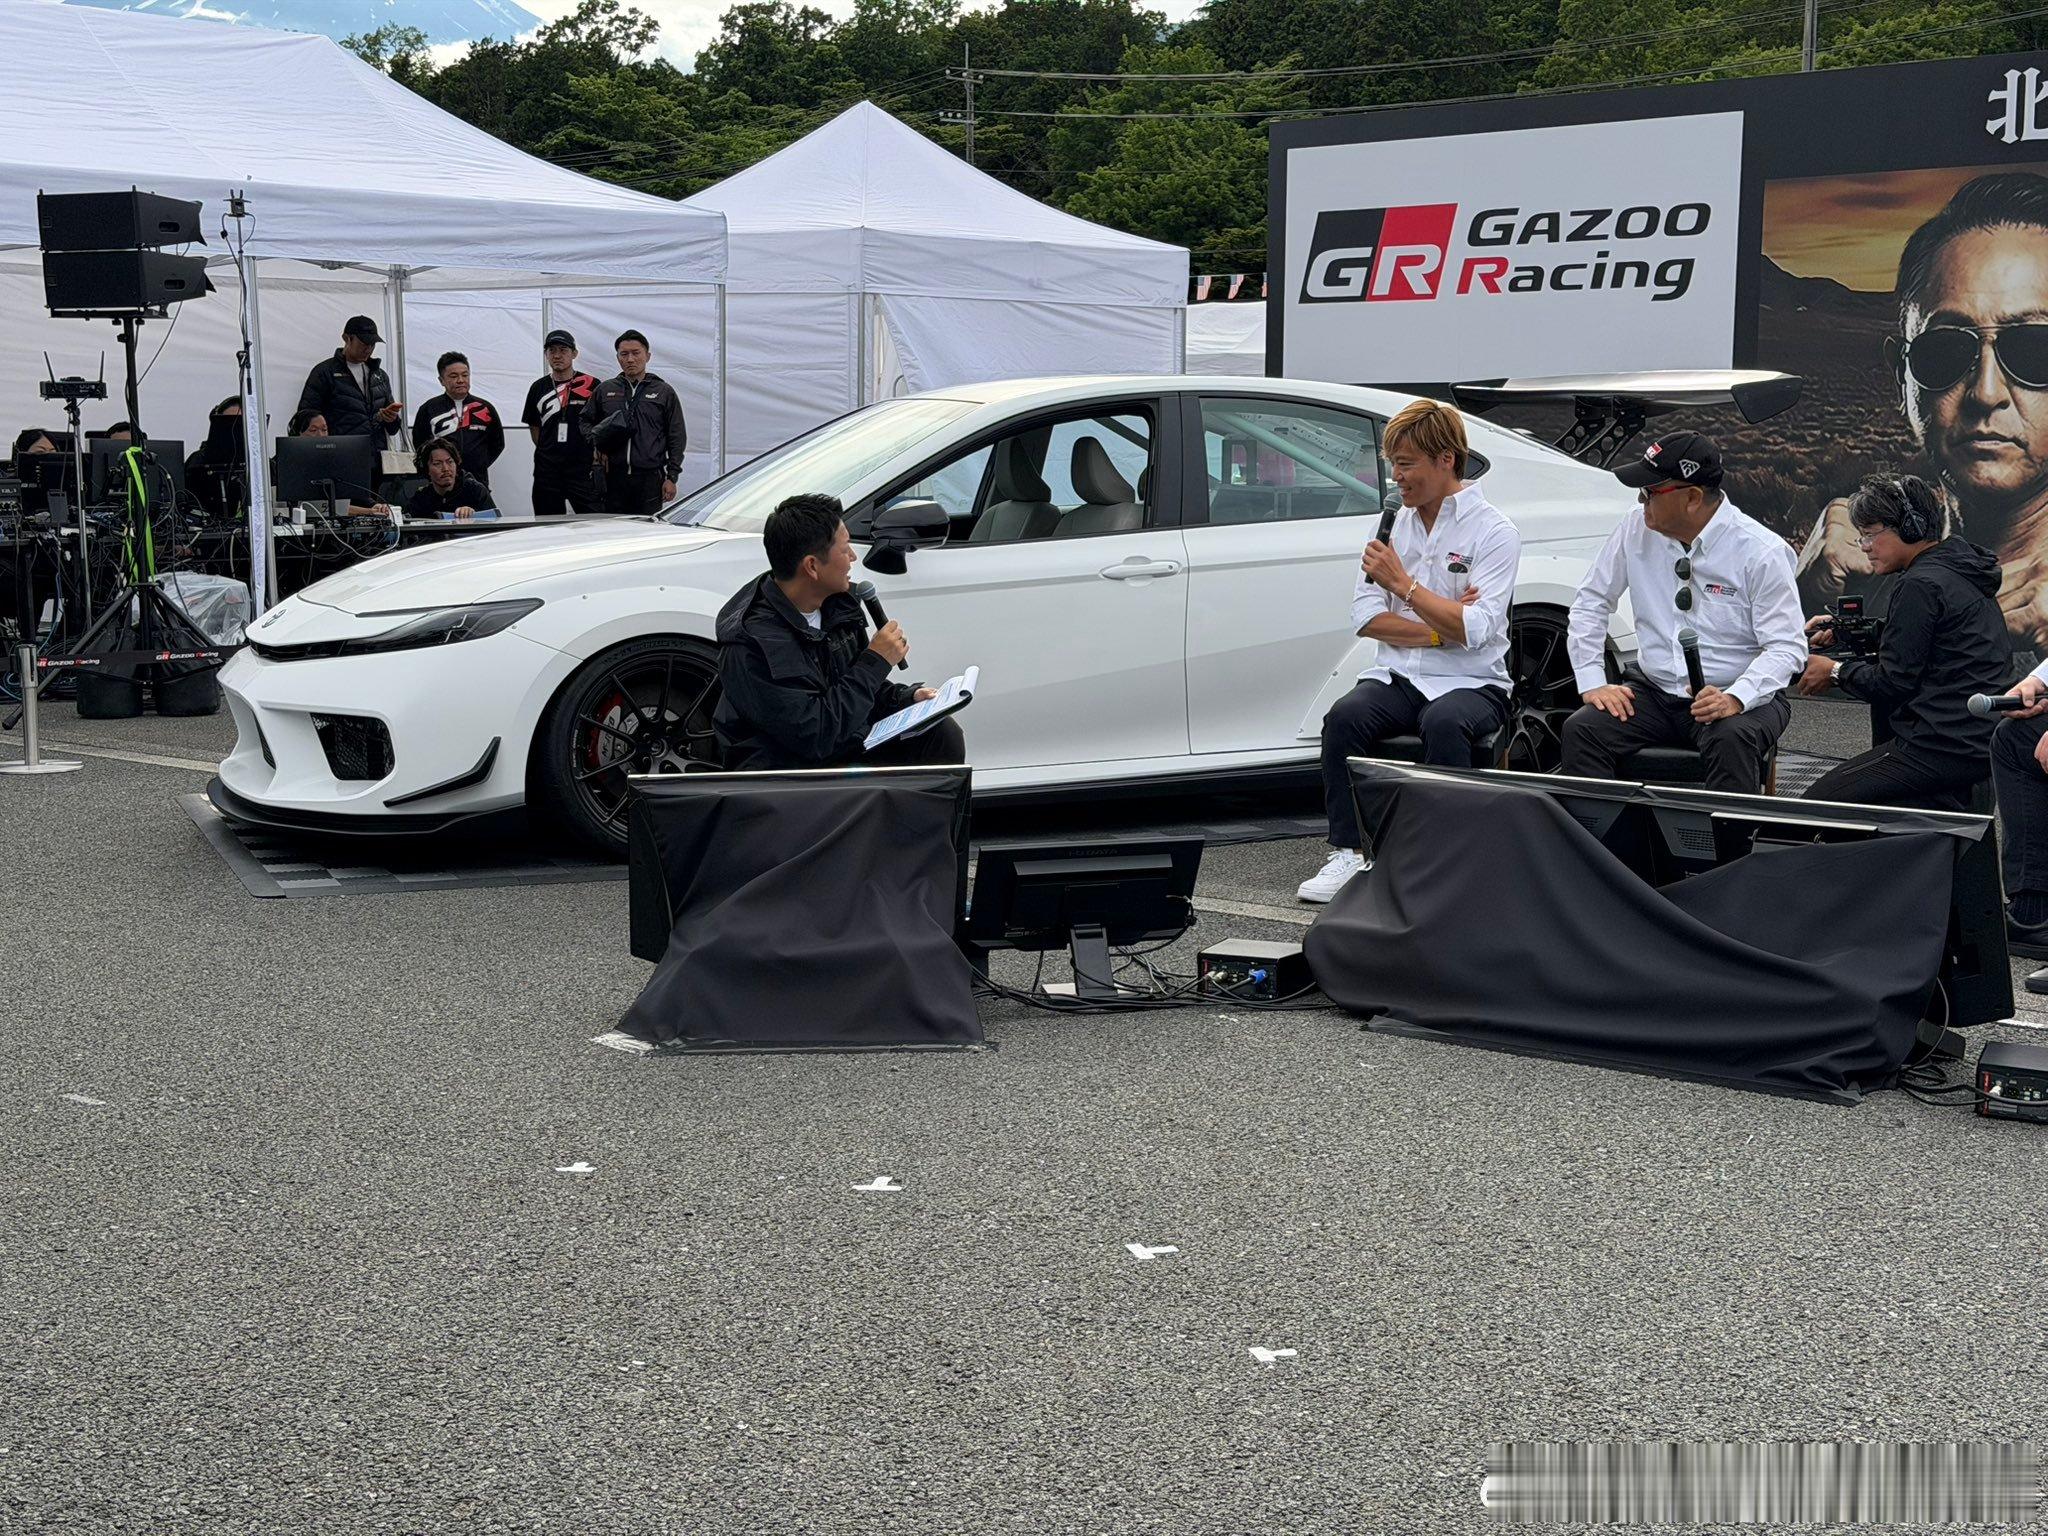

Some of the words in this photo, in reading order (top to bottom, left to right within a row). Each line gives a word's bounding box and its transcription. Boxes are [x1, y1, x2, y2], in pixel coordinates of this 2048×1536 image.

[1466, 202, 1712, 247] GAZOO
[1304, 242, 1444, 300] GR
[1456, 250, 1697, 302] Racing
[430, 401, 492, 439] GR
[537, 375, 594, 427] GR
[195, 651, 219, 659] Racing
